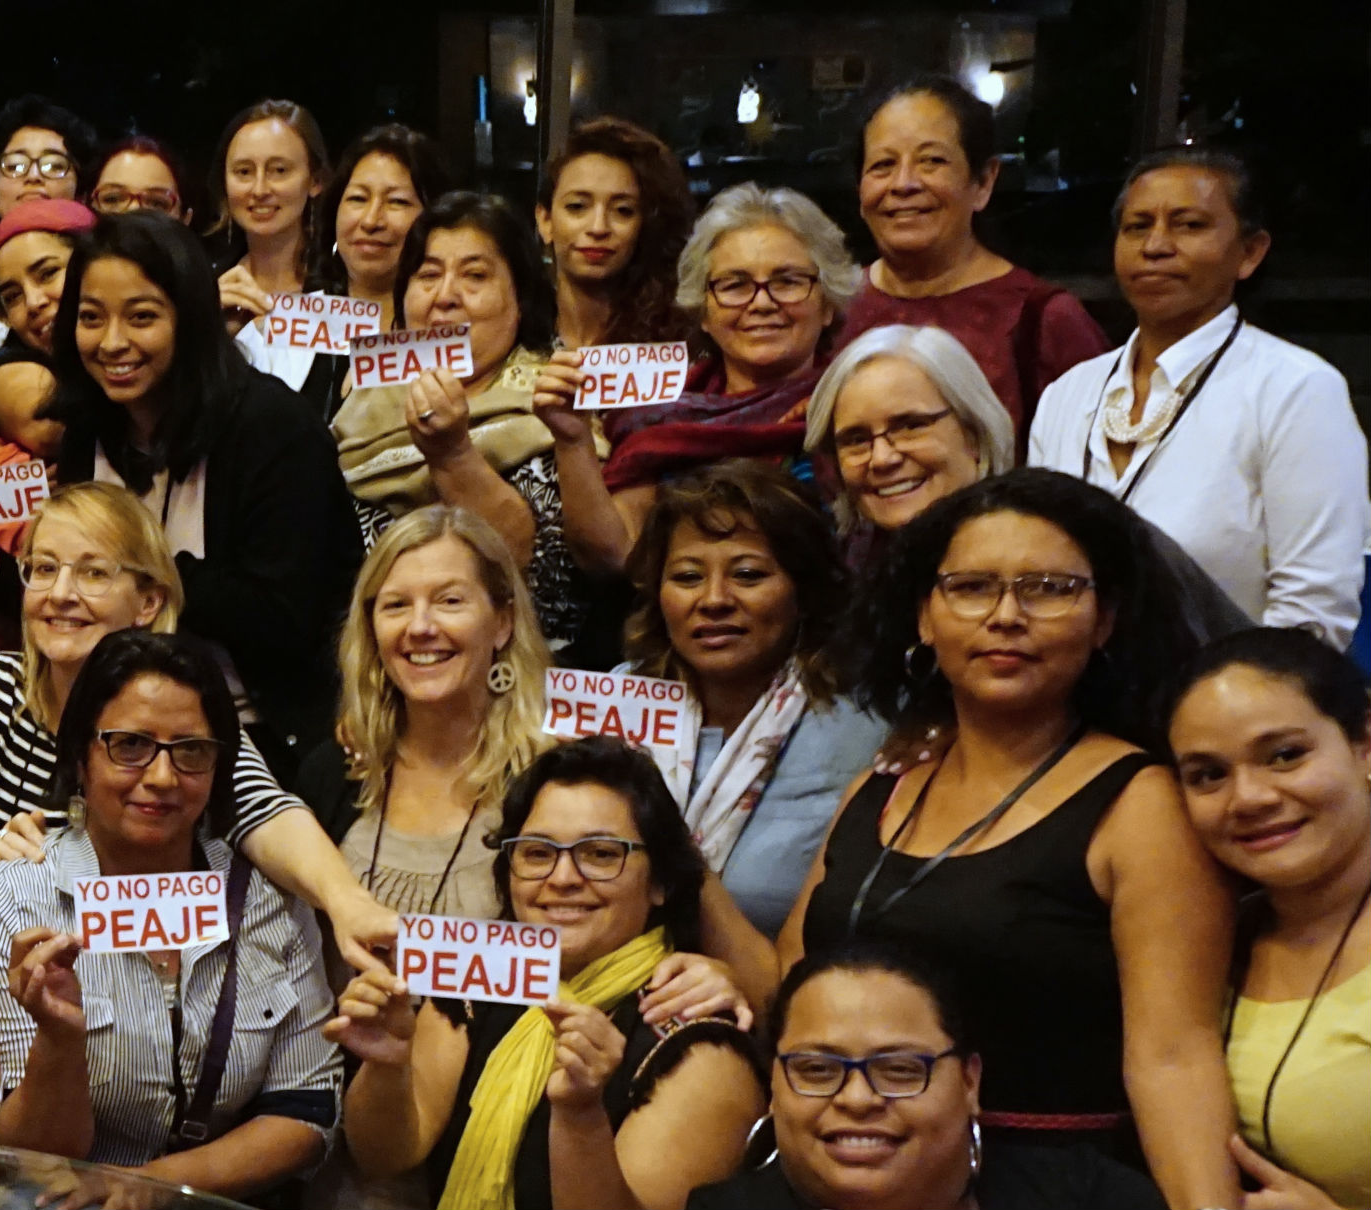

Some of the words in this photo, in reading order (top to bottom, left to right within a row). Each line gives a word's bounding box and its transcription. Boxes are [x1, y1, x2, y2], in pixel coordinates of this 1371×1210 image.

[270, 294, 295, 311] YO
[299, 296, 325, 314] NO
[329, 298, 380, 318] PAGO
[351, 337, 378, 350] YO
[383, 332, 411, 347] NO
[580, 348, 601, 366] YO
[607, 347, 631, 365] NO
[636, 344, 685, 364] PAGO
[578, 370, 682, 406] PEAJE
[549, 671, 577, 692] YO
[583, 675, 615, 696] NO
[621, 678, 685, 702] PAGO
[548, 697, 678, 746] PEAJE
[77, 880, 110, 902] YO
[117, 878, 150, 900] NO
[157, 874, 222, 898] PAGO
[81, 904, 219, 950] PEAJE
[401, 916, 435, 940] YO
[442, 920, 478, 943] NO
[486, 923, 558, 949] PAGO
[402, 947, 551, 1000] PEAJE
